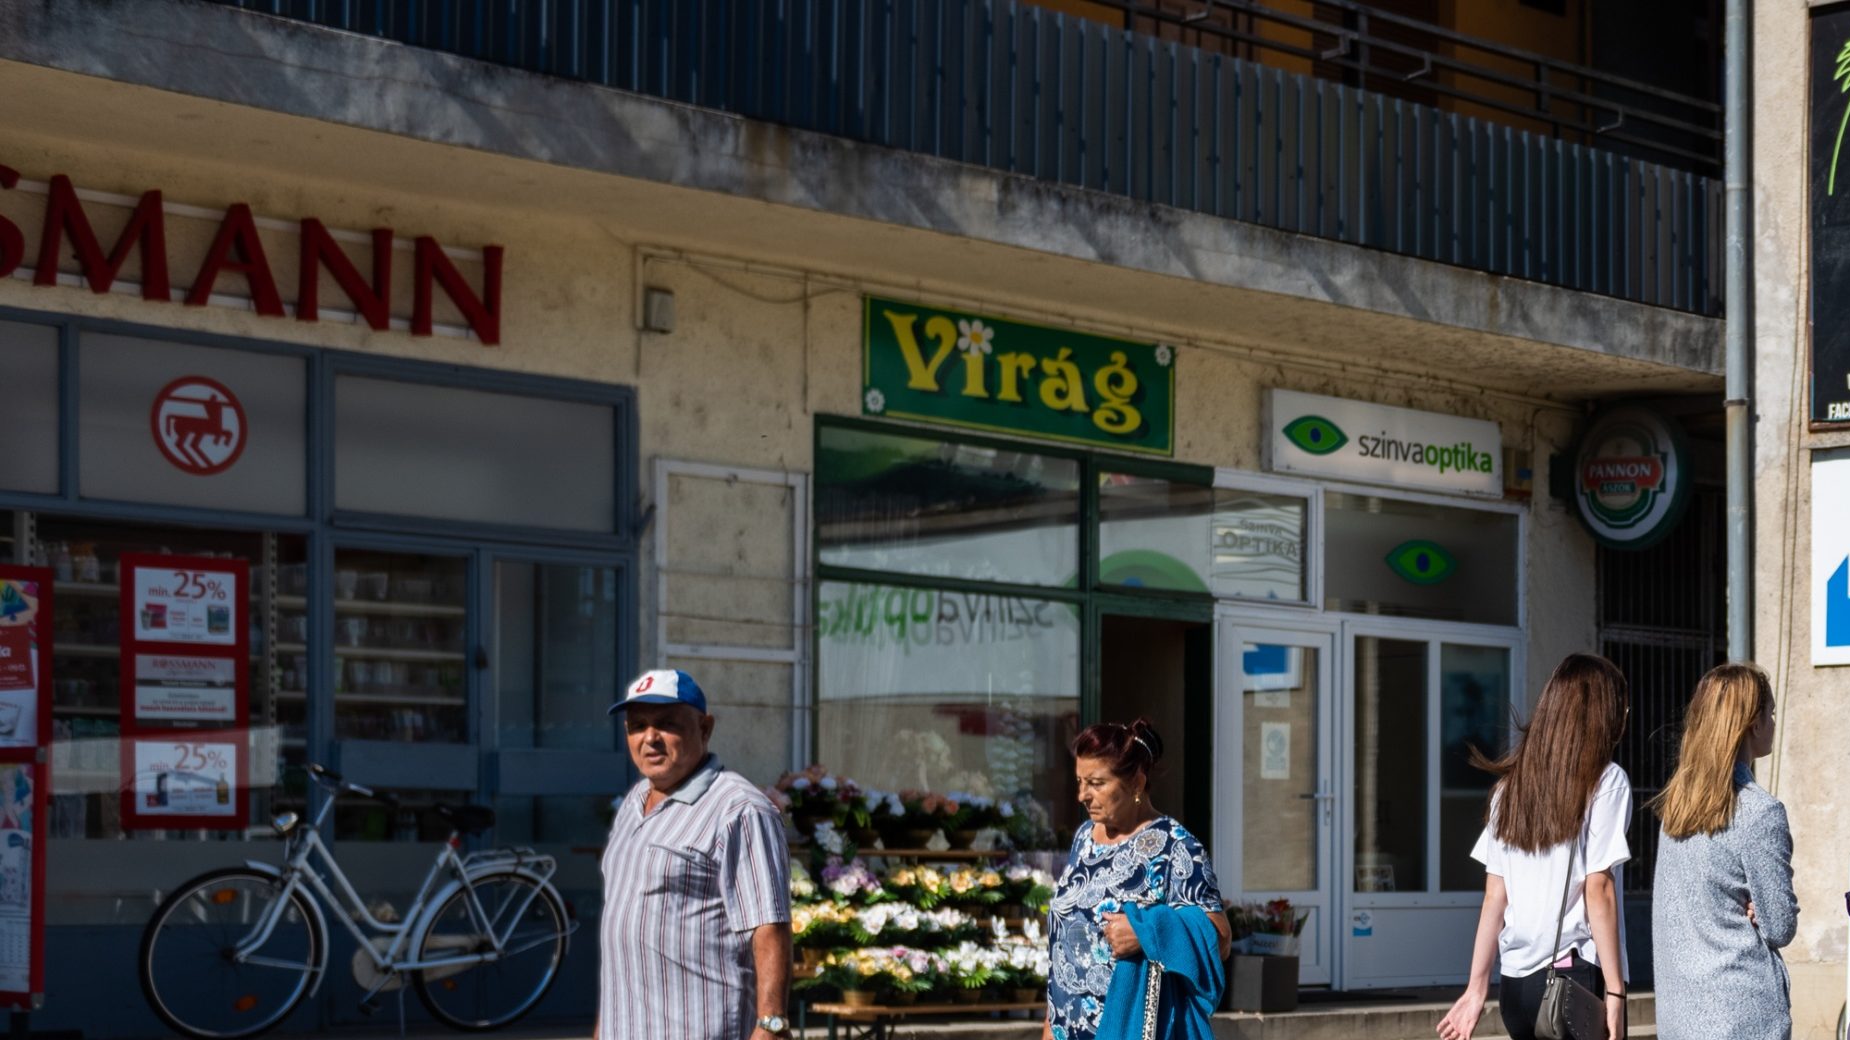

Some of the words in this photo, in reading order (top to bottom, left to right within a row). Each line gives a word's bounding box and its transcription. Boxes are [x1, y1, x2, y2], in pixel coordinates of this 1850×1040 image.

[883, 309, 1141, 434] Virág
[1358, 431, 1493, 474] szinvaoptika
[1589, 461, 1652, 478] PANNON
[1223, 531, 1298, 557] OPTIKA
[174, 571, 226, 600] 25%
[174, 744, 227, 772] 25%
